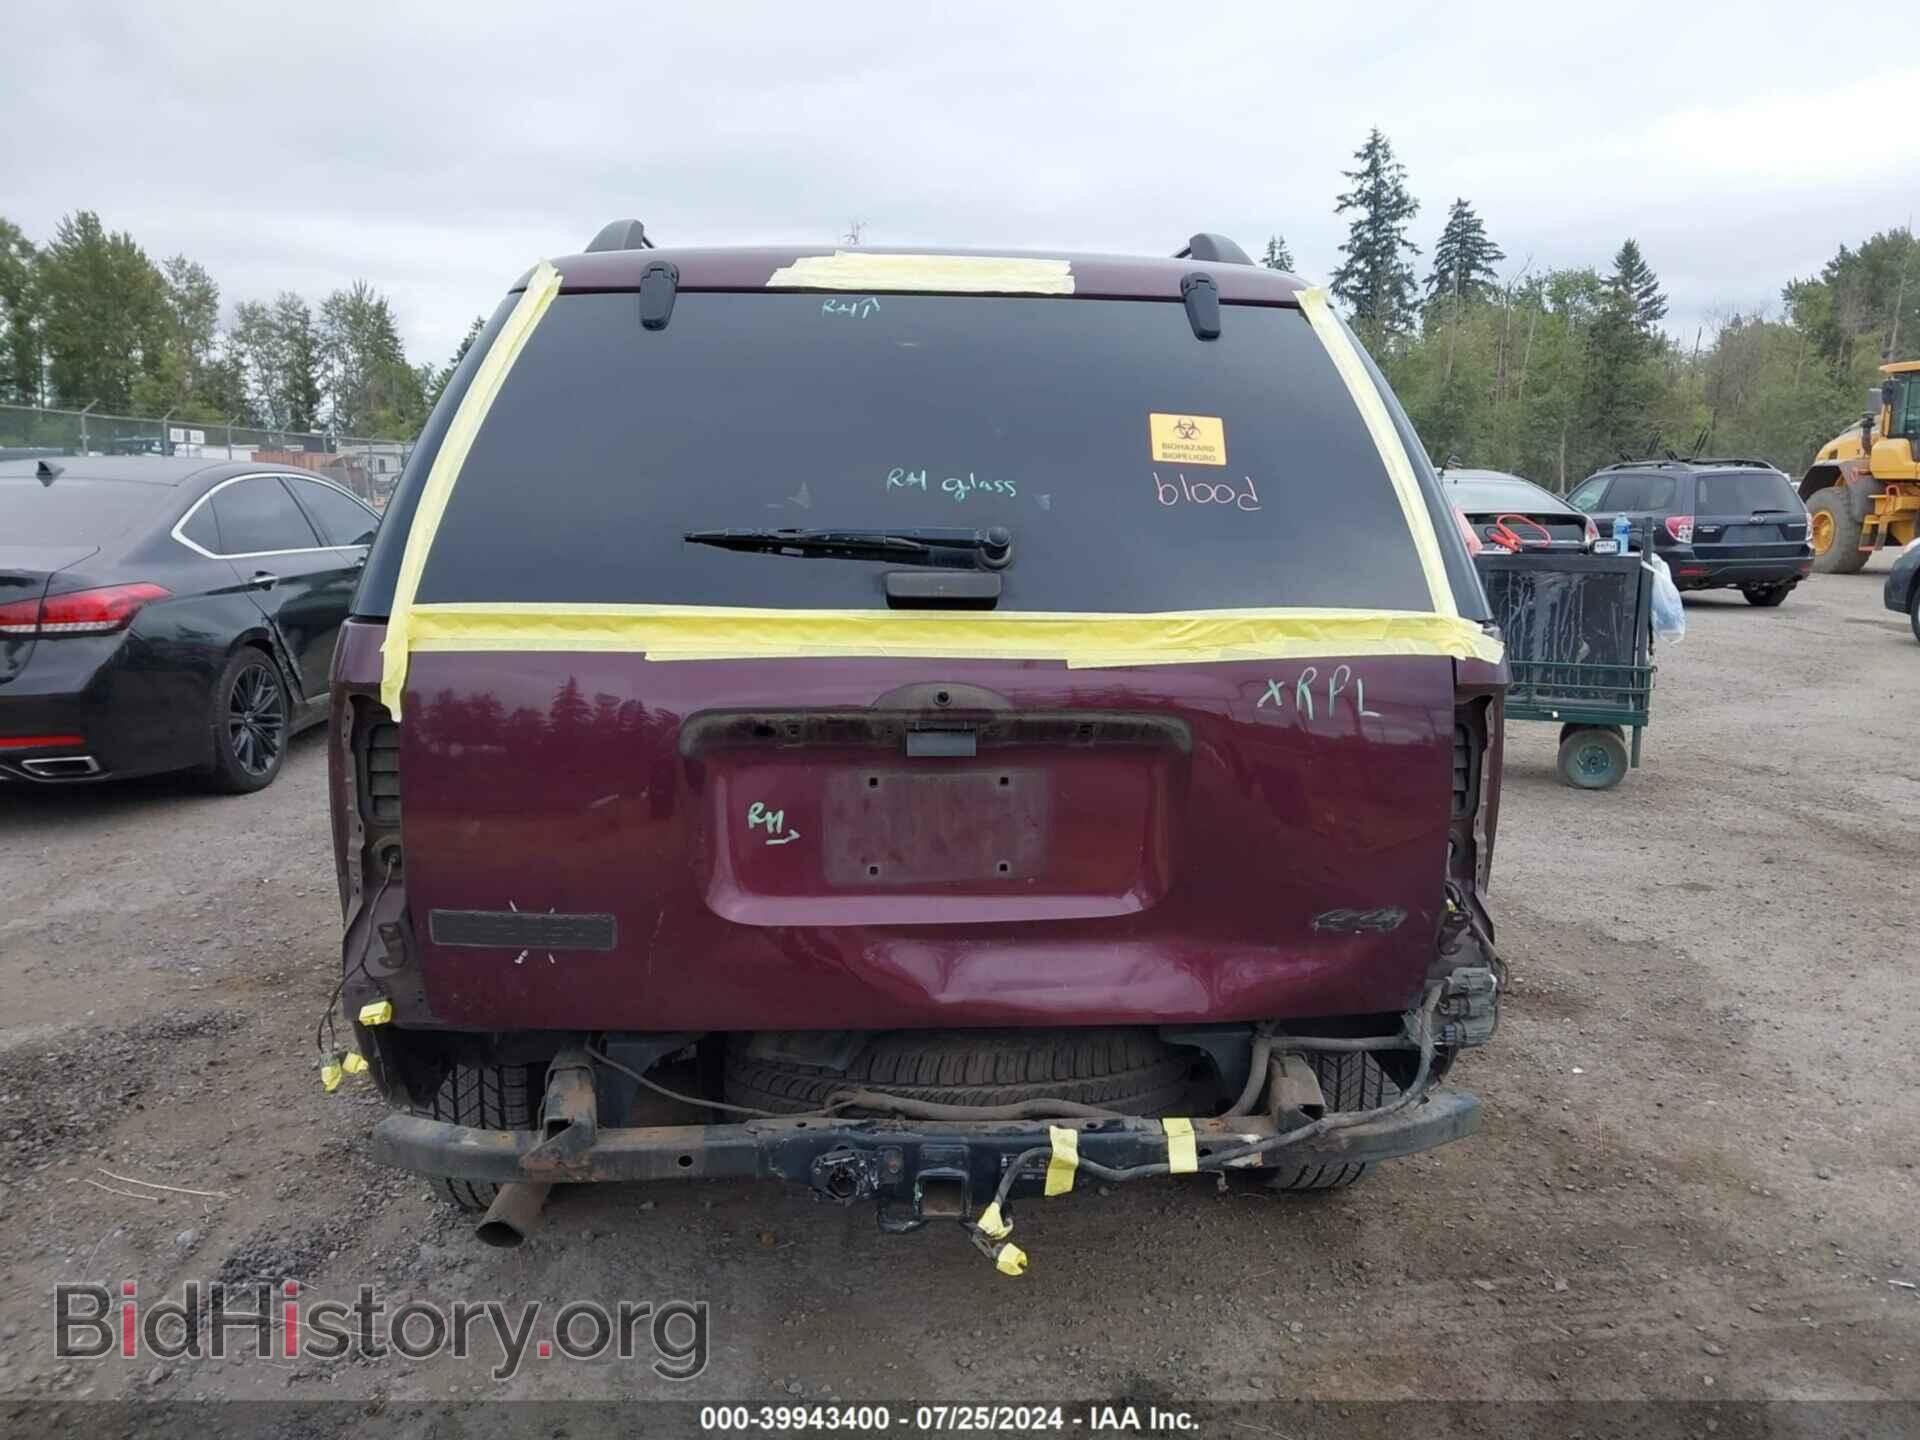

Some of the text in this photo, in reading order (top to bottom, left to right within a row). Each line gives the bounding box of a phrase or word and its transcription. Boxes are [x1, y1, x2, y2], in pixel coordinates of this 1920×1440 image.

[1161, 442, 1215, 453] BIOHAZARD
[1162, 452, 1216, 462] BIOPELIGRO
[941, 472, 1017, 502] glass
[1152, 471, 1262, 511] blood
